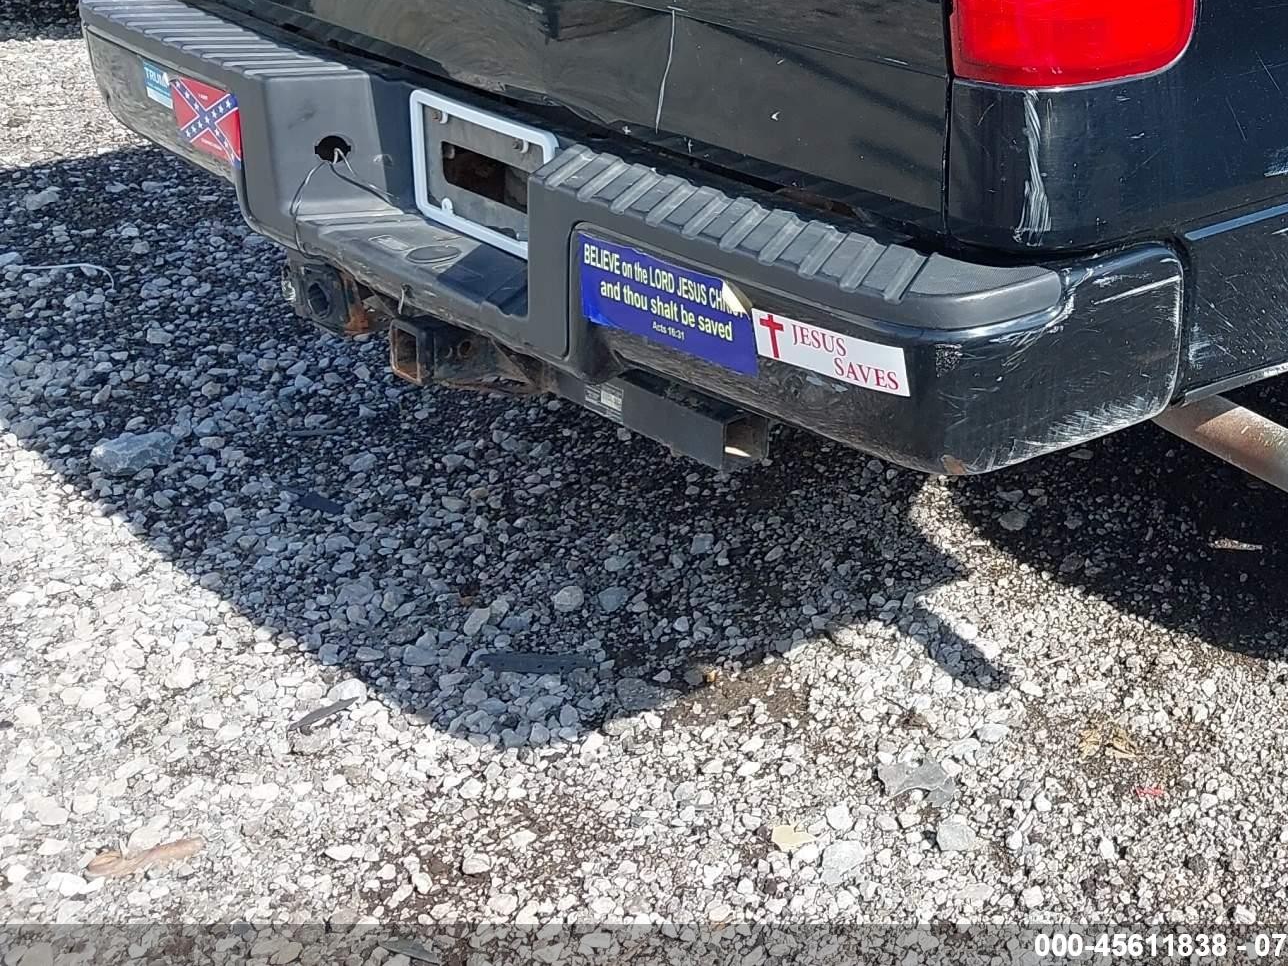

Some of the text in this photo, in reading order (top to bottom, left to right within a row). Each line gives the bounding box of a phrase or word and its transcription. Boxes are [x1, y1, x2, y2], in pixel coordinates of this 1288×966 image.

[144, 67, 169, 88] TRUM
[584, 243, 621, 274] BELIEVE
[622, 261, 633, 279] on
[634, 262, 648, 284] the
[649, 266, 675, 293] LORD
[677, 277, 707, 306] JESUS
[600, 280, 733, 341] and thou shalt be saved
[652, 321, 667, 334] Acts
[791, 324, 847, 357] JESUS
[834, 357, 899, 390] SAVES
